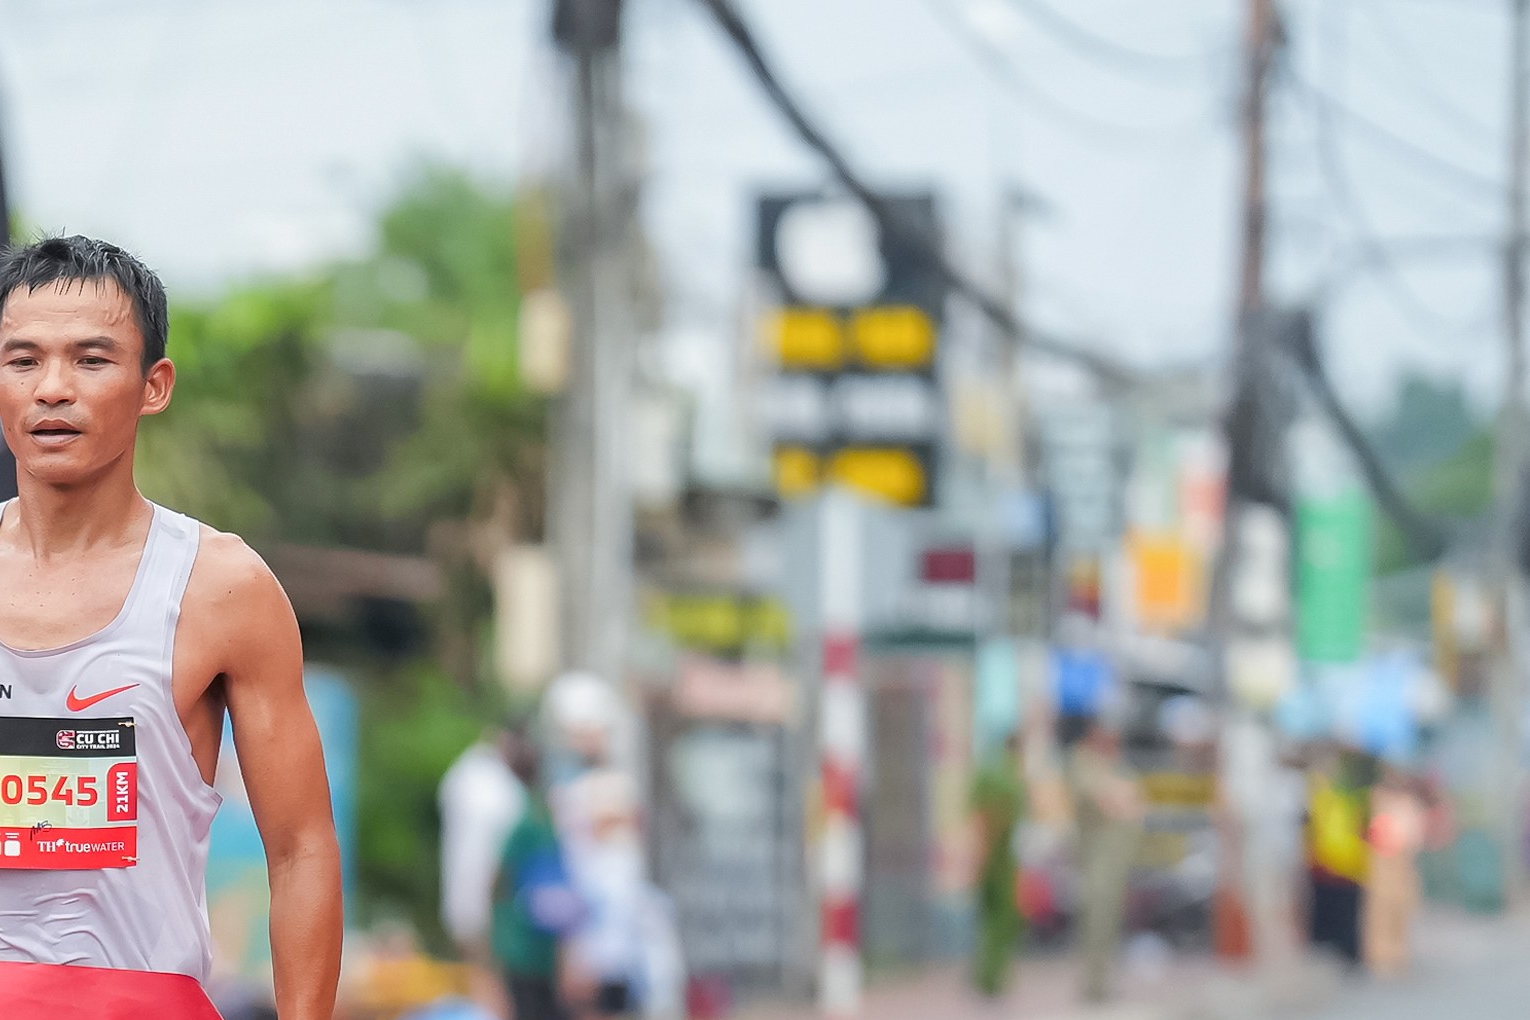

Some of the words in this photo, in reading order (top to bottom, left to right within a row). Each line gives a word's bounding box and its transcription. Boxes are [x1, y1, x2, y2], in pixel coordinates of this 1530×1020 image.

[76, 734, 94, 744] CU
[98, 733, 120, 744] CHI
[116, 771, 129, 813] 21KM
[37, 841, 56, 853] TH
